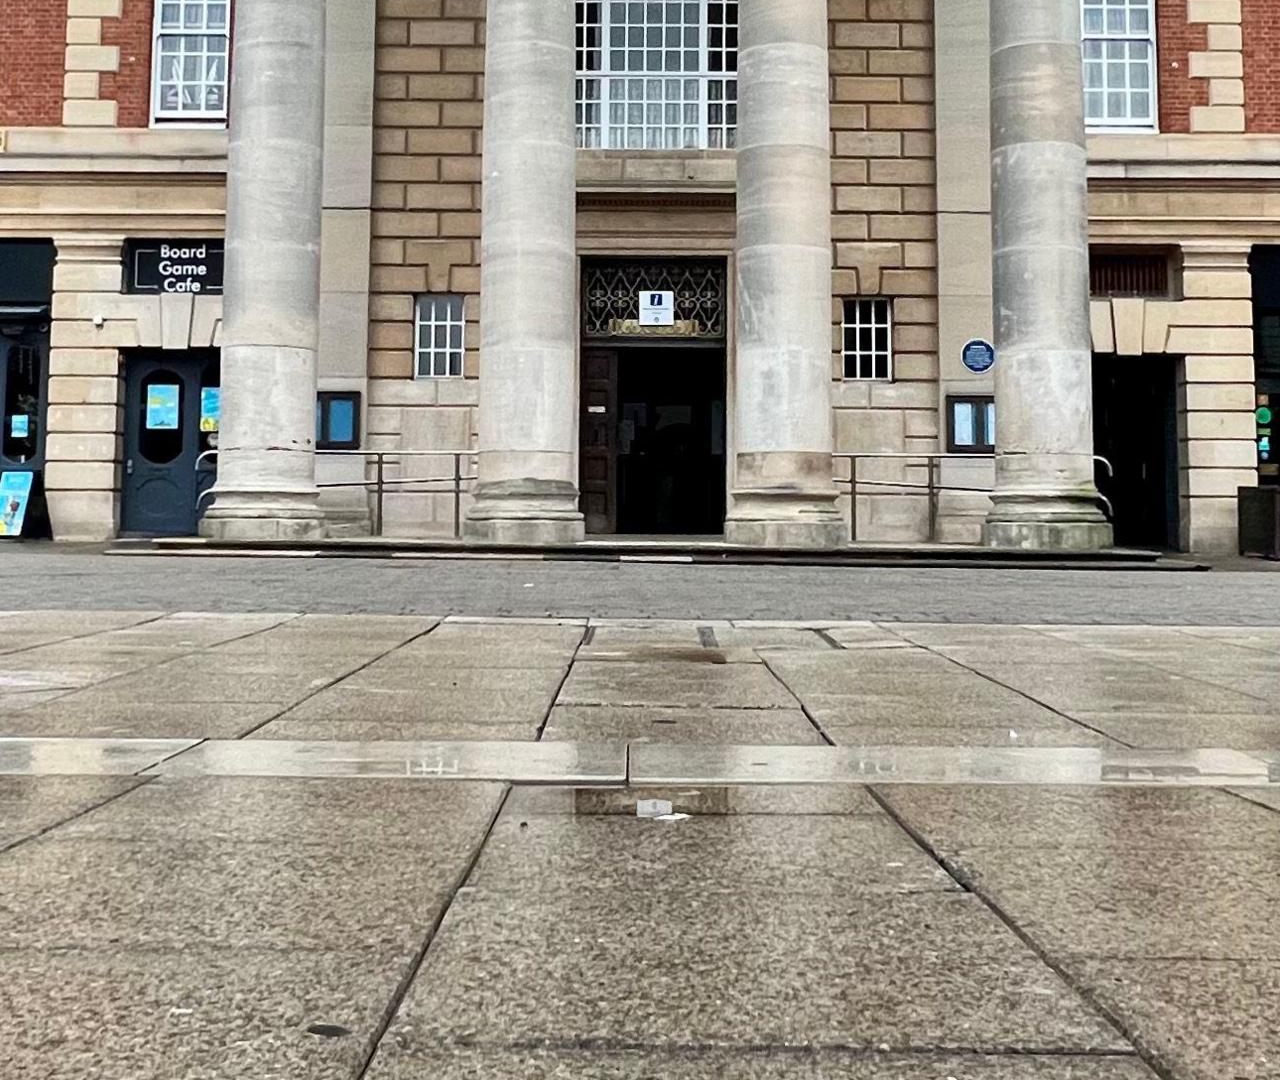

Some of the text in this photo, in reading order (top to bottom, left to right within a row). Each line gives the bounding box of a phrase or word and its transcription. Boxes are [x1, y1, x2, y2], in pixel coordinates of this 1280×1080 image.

[160, 244, 206, 259] Board
[158, 260, 207, 276] Game
[164, 277, 201, 292] Cafe
